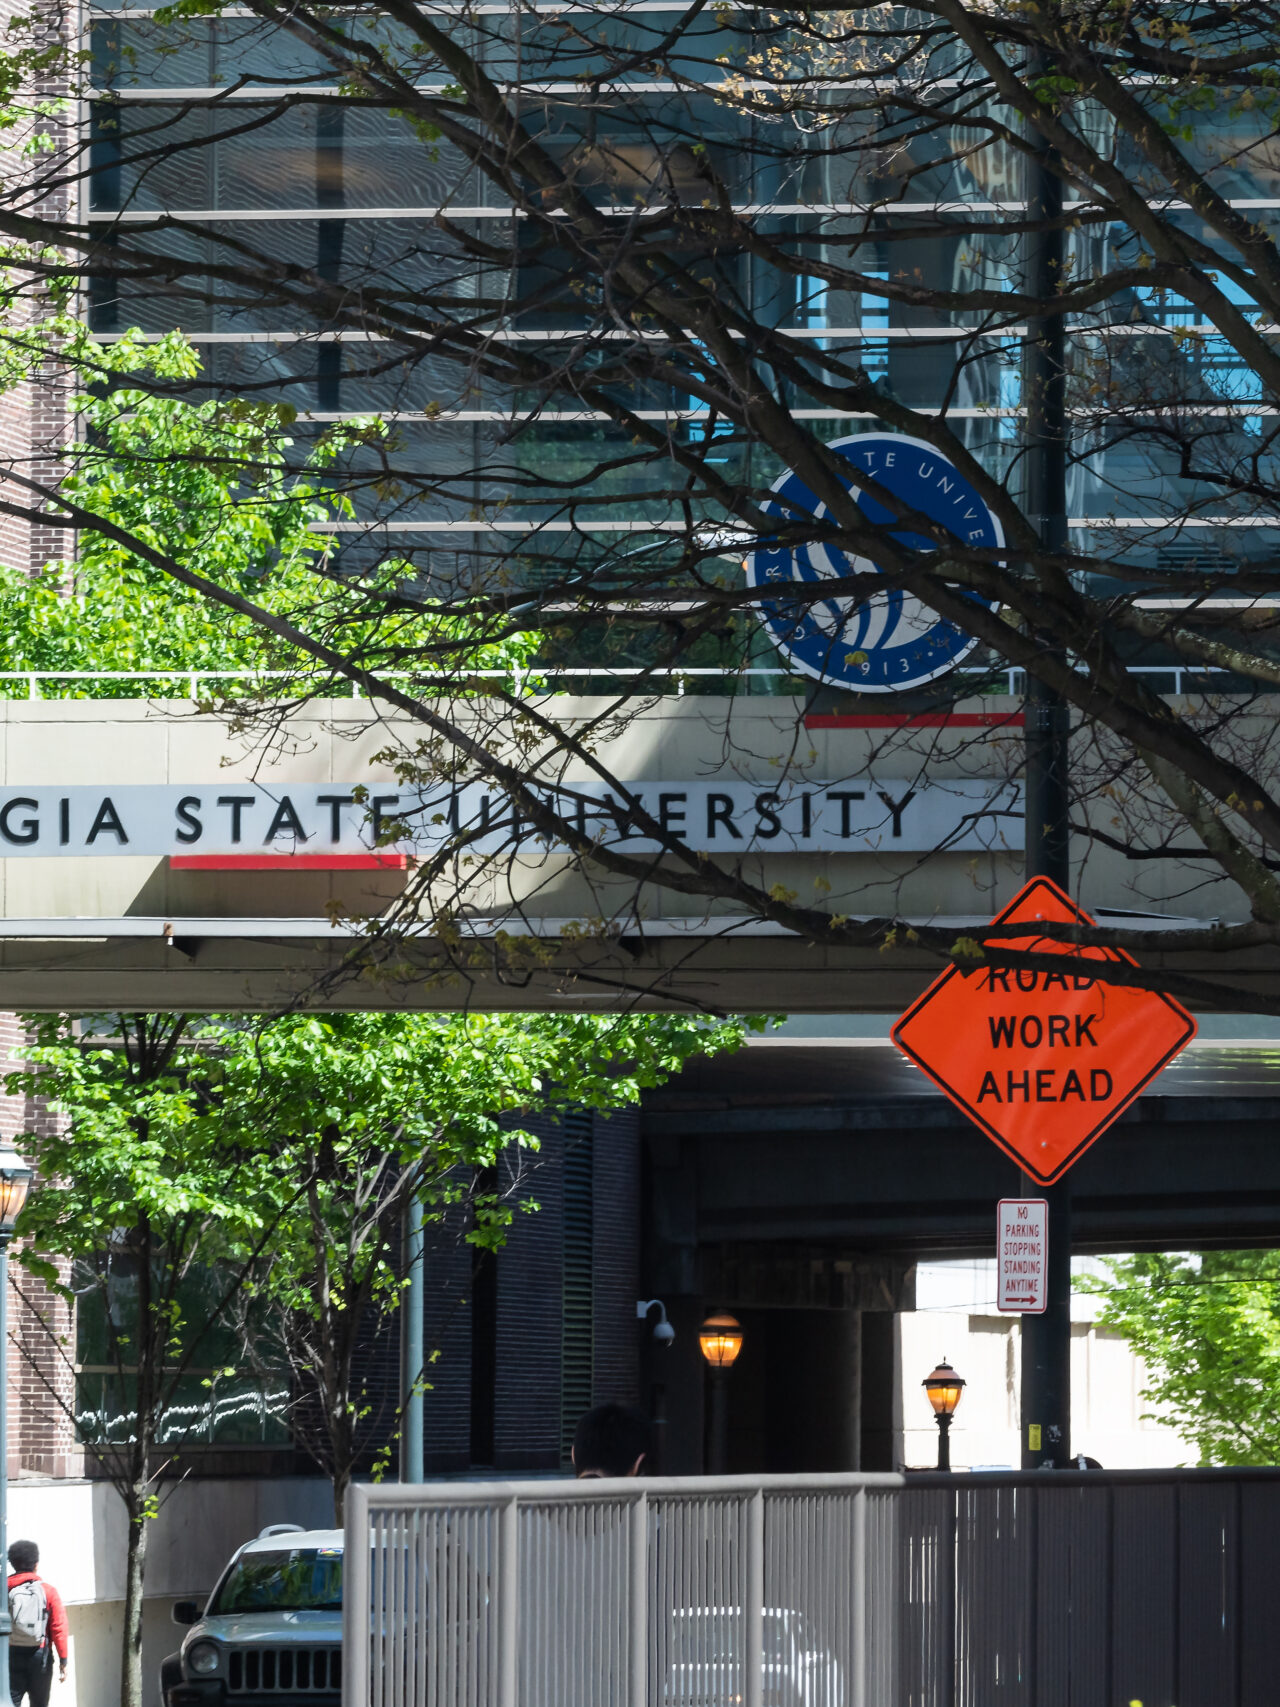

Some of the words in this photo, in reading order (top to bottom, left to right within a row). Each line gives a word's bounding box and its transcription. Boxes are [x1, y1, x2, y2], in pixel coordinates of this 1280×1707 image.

[175, 794, 401, 845] STATE
[988, 1014, 1098, 1049] WORK
[976, 1069, 1113, 1103] AHEAD
[1017, 1206, 1028, 1220] NO
[1005, 1224, 1039, 1237] PARKING
[1004, 1242, 1041, 1256] STOPPING
[1004, 1260, 1041, 1274] STANDING
[1005, 1279, 1038, 1292] ANYTIME
